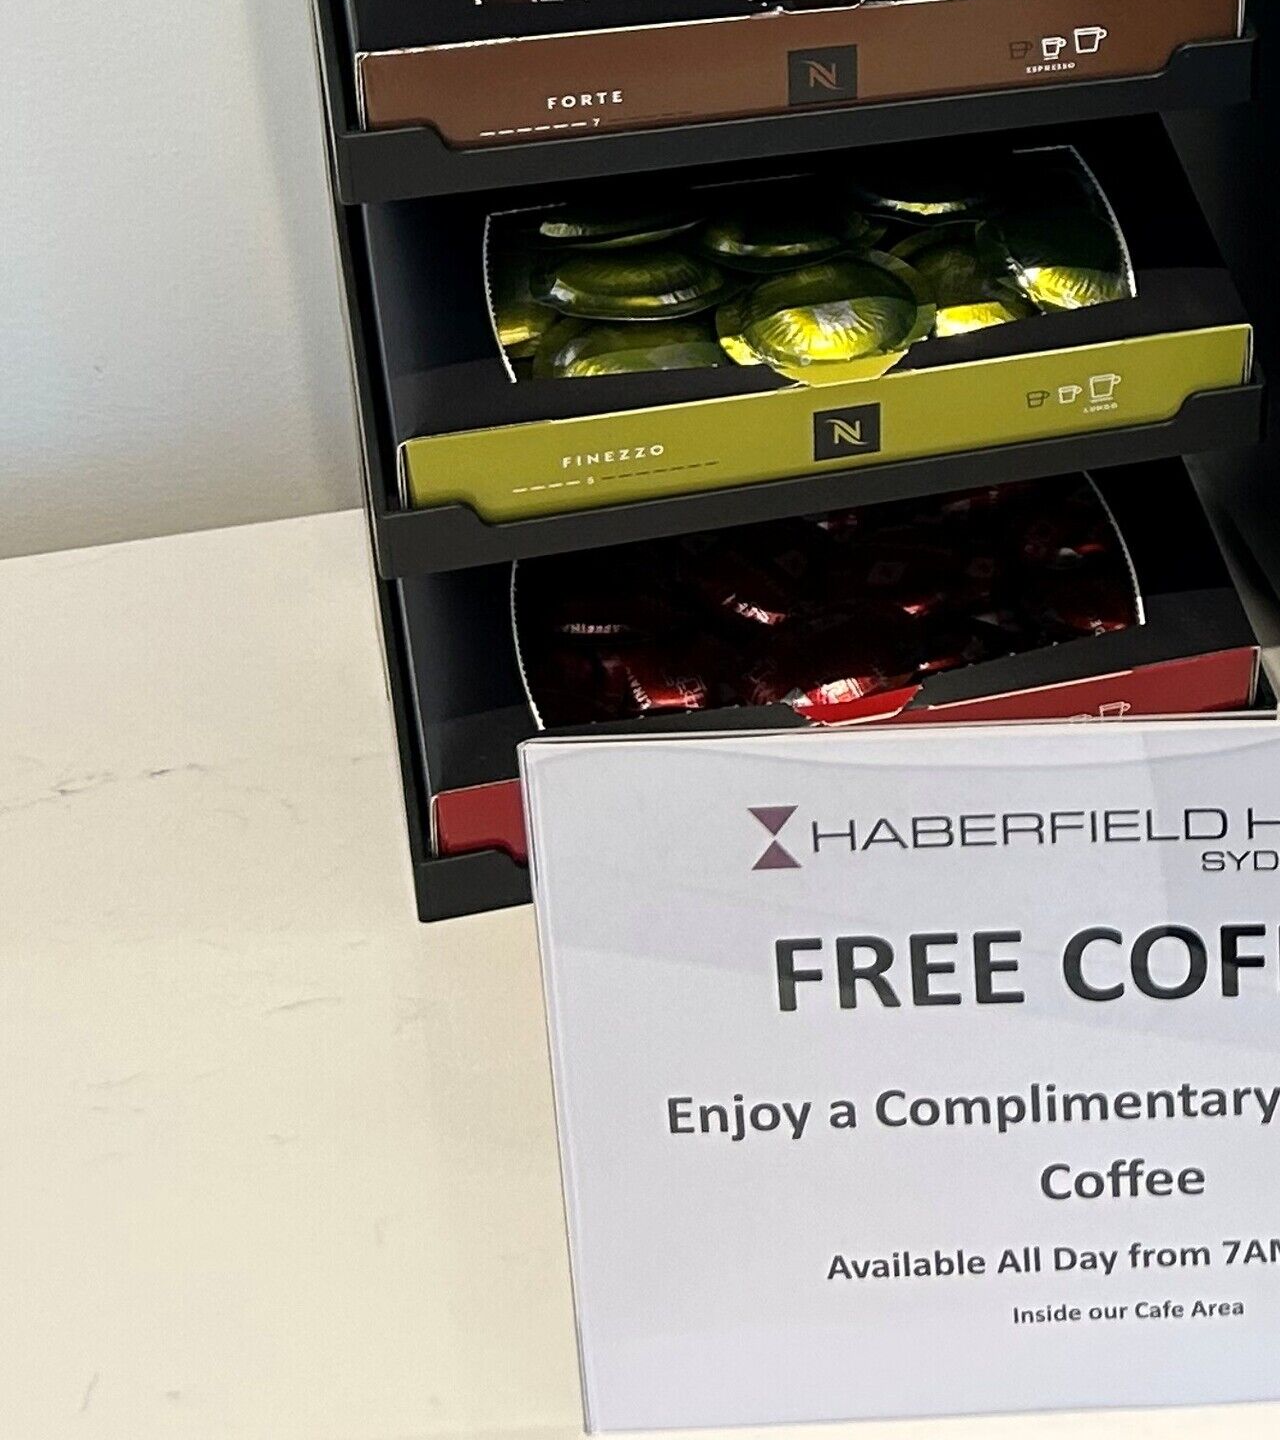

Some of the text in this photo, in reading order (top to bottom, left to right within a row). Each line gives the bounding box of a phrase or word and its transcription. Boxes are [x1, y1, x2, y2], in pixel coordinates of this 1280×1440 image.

[547, 90, 623, 110] FORTE
[562, 444, 664, 469] FINEZZO
[811, 806, 1229, 854] HABERFIELD
[775, 930, 1025, 1012] FREE
[667, 1093, 812, 1142] Enjoy
[829, 1100, 857, 1129] a
[1040, 1158, 1205, 1201] Coffee
[827, 1248, 986, 1280] Available
[997, 1246, 1041, 1274] All
[1053, 1247, 1118, 1276] Day
[1128, 1242, 1211, 1269] from
[1012, 1299, 1245, 1324] Inside our Cafe Area
